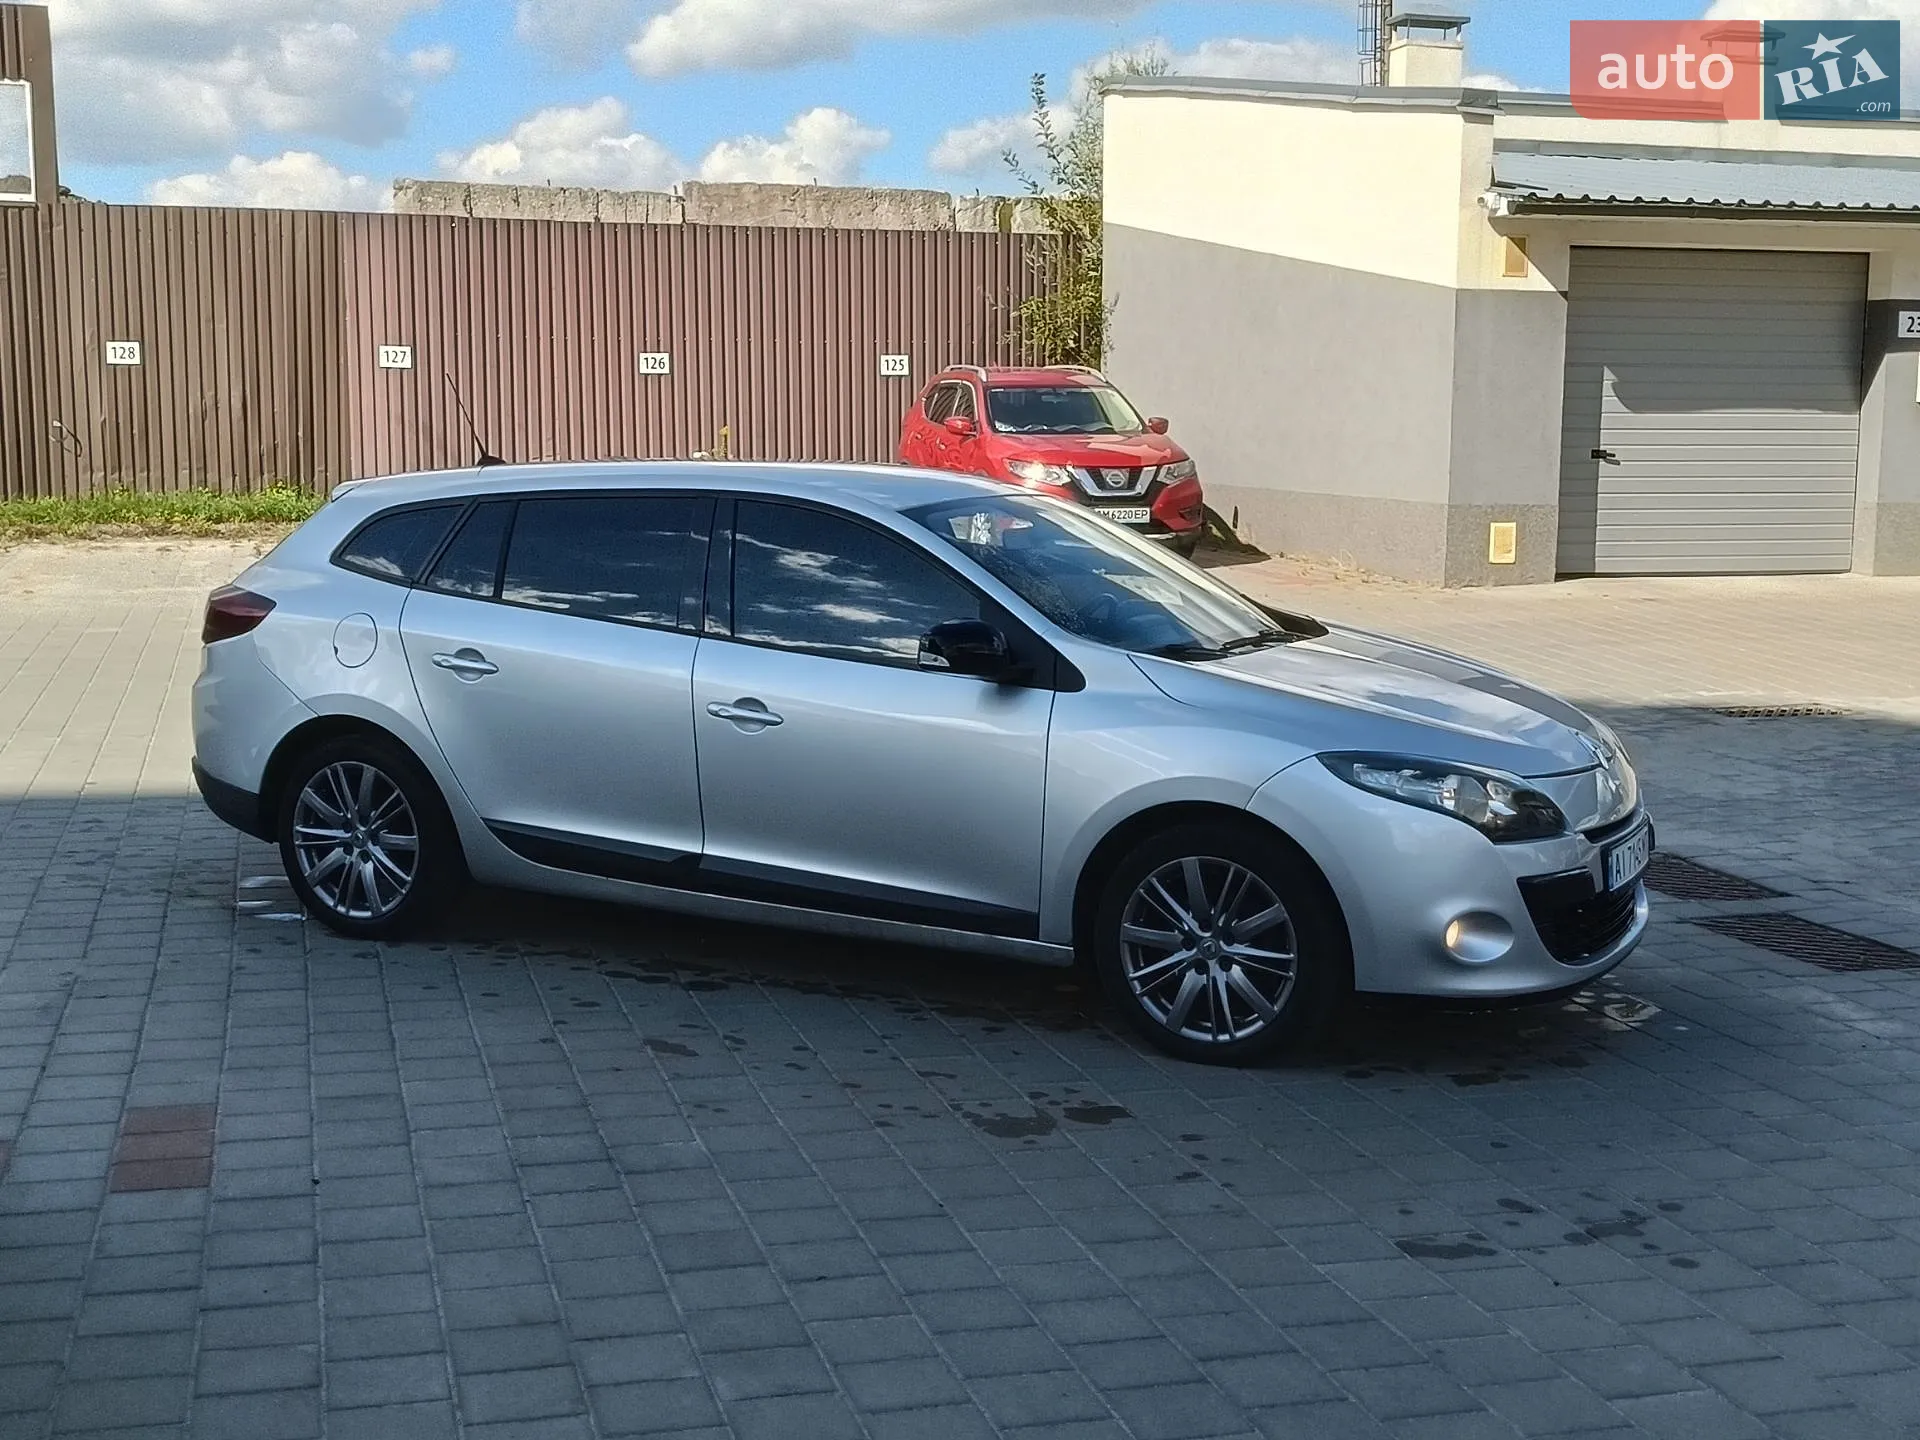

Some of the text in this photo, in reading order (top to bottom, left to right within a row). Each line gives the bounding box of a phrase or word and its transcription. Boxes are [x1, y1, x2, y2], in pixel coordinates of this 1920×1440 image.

[111, 346, 136, 360] 128
[383, 350, 407, 364] 127
[643, 356, 666, 370] 126
[884, 358, 905, 371] 125
